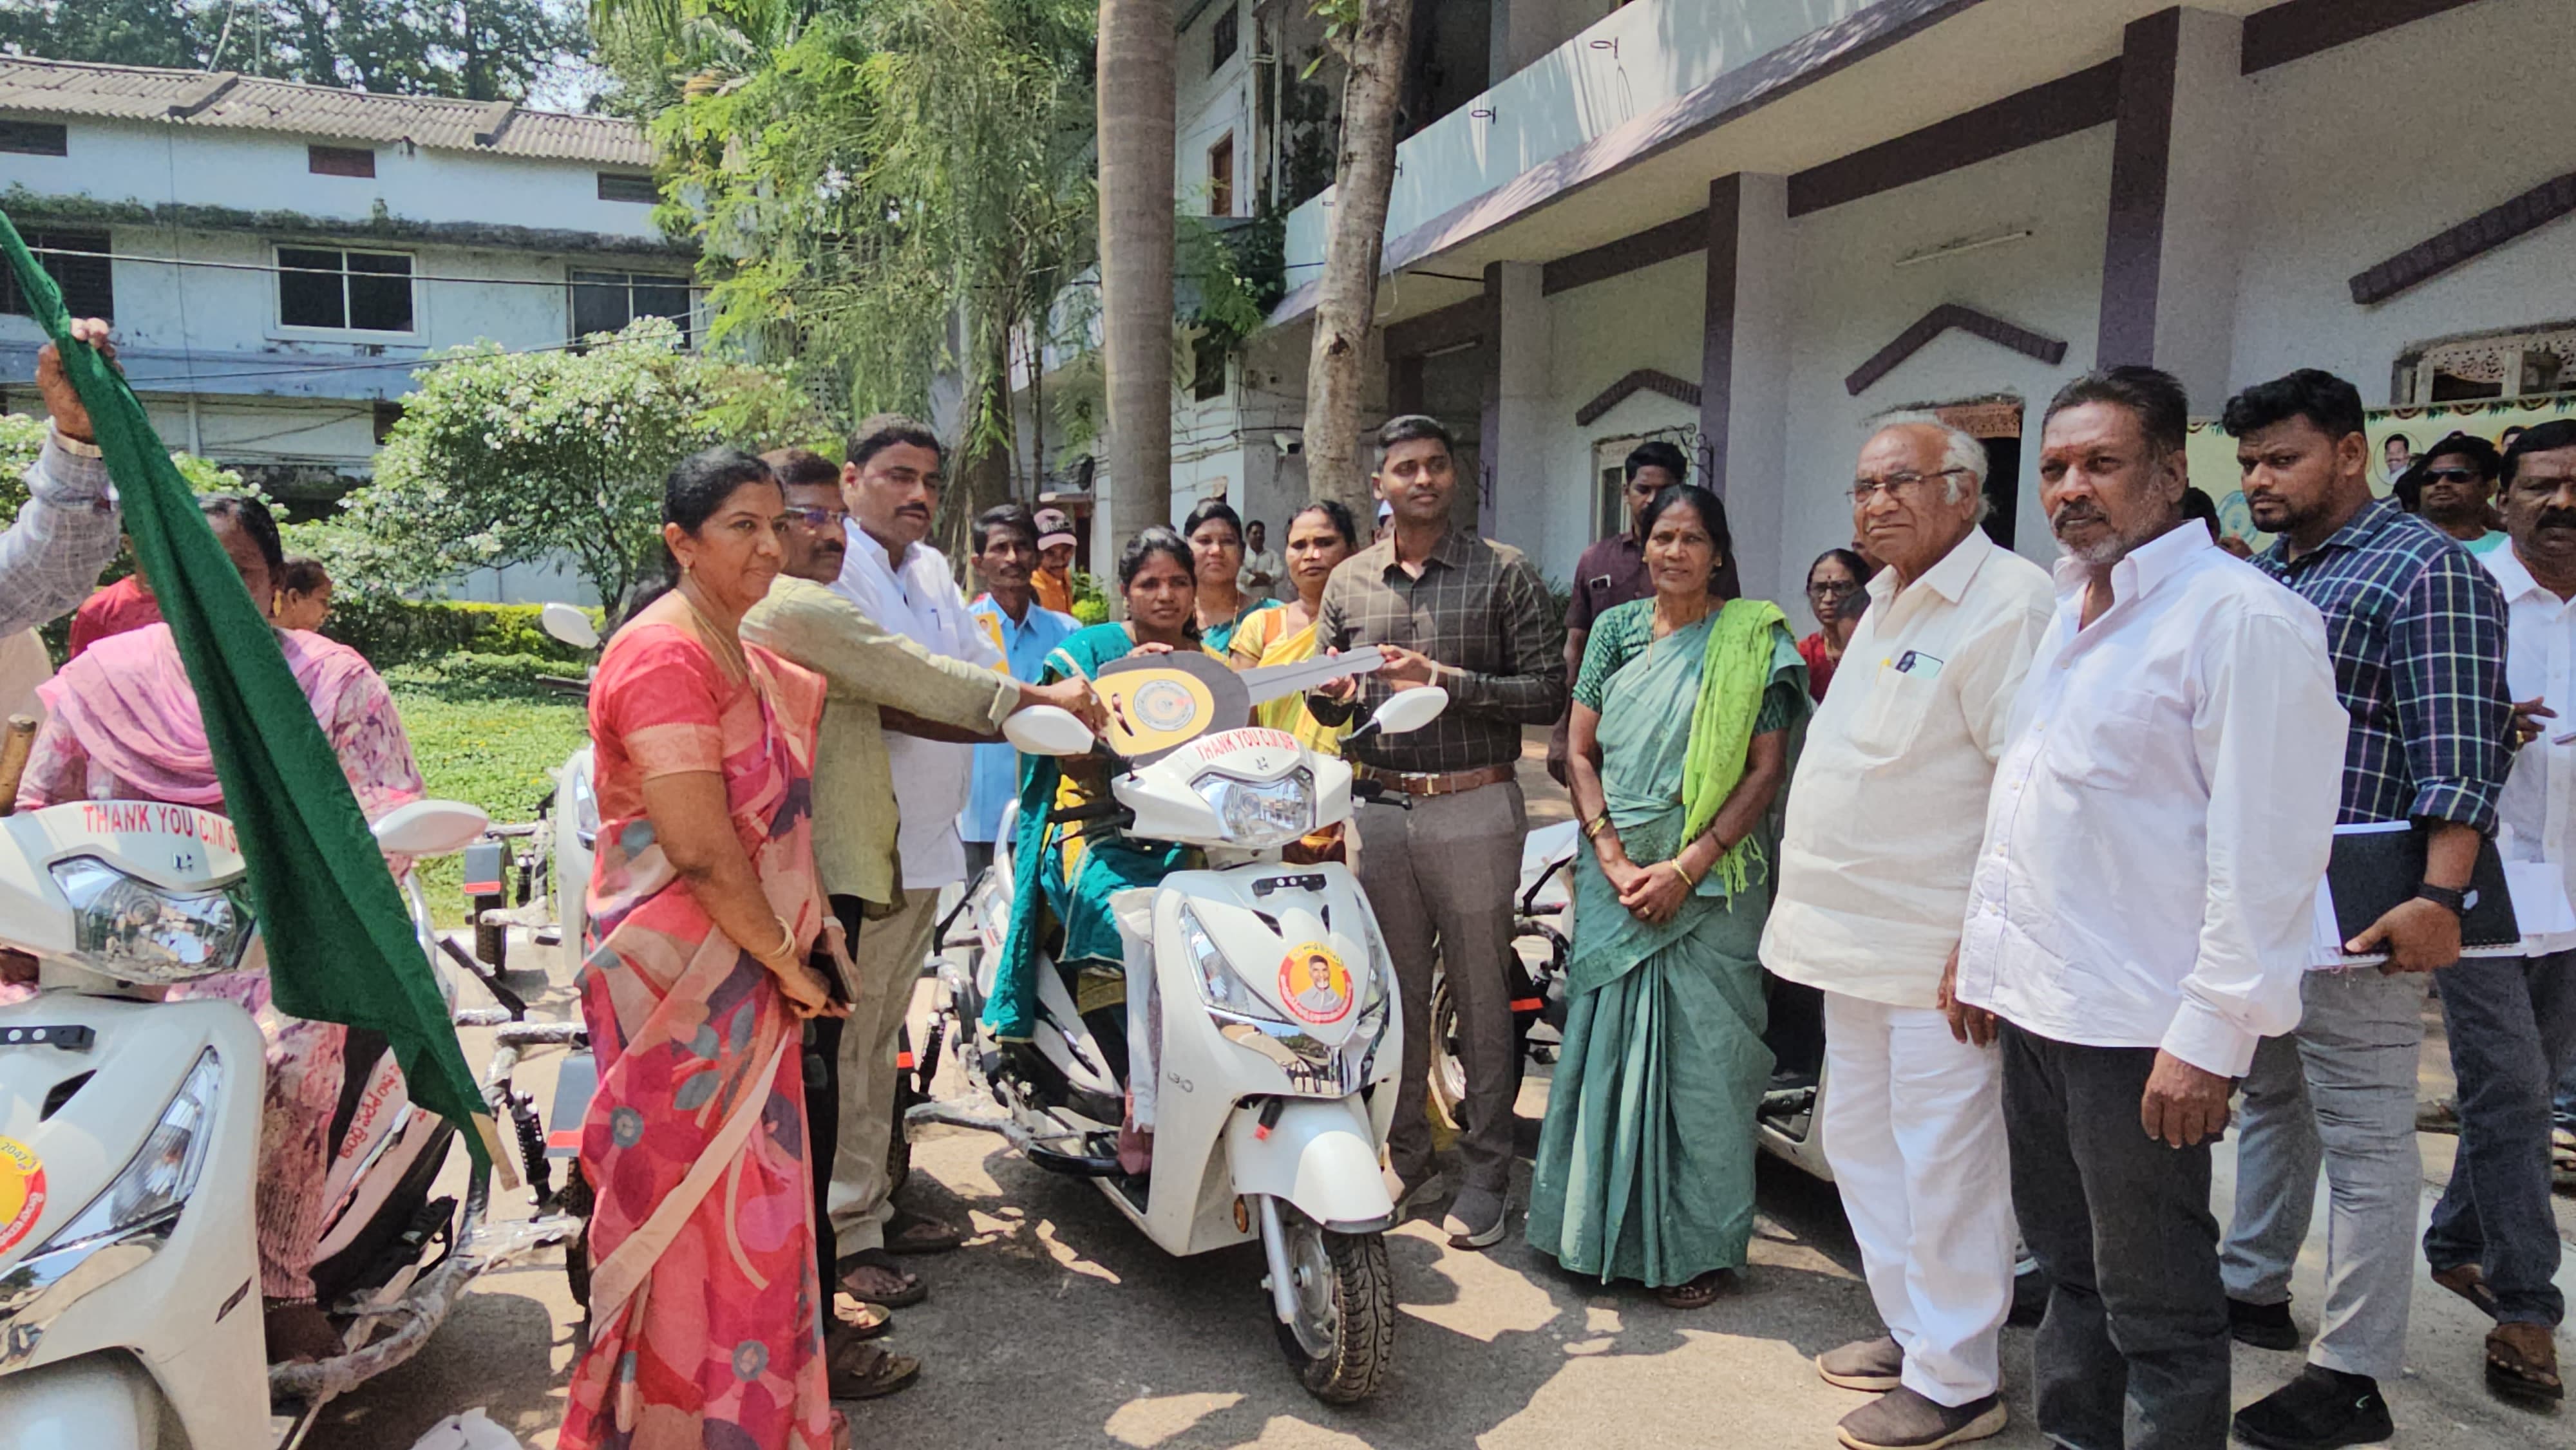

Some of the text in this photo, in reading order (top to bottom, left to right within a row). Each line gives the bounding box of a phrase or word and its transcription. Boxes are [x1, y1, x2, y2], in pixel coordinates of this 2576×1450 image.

[1196, 733, 1237, 762] THANK
[1233, 730, 1260, 749] YOU
[82, 804, 151, 833] THANK
[156, 805, 193, 838] YOU
[1, 1142, 27, 1162] 2047
